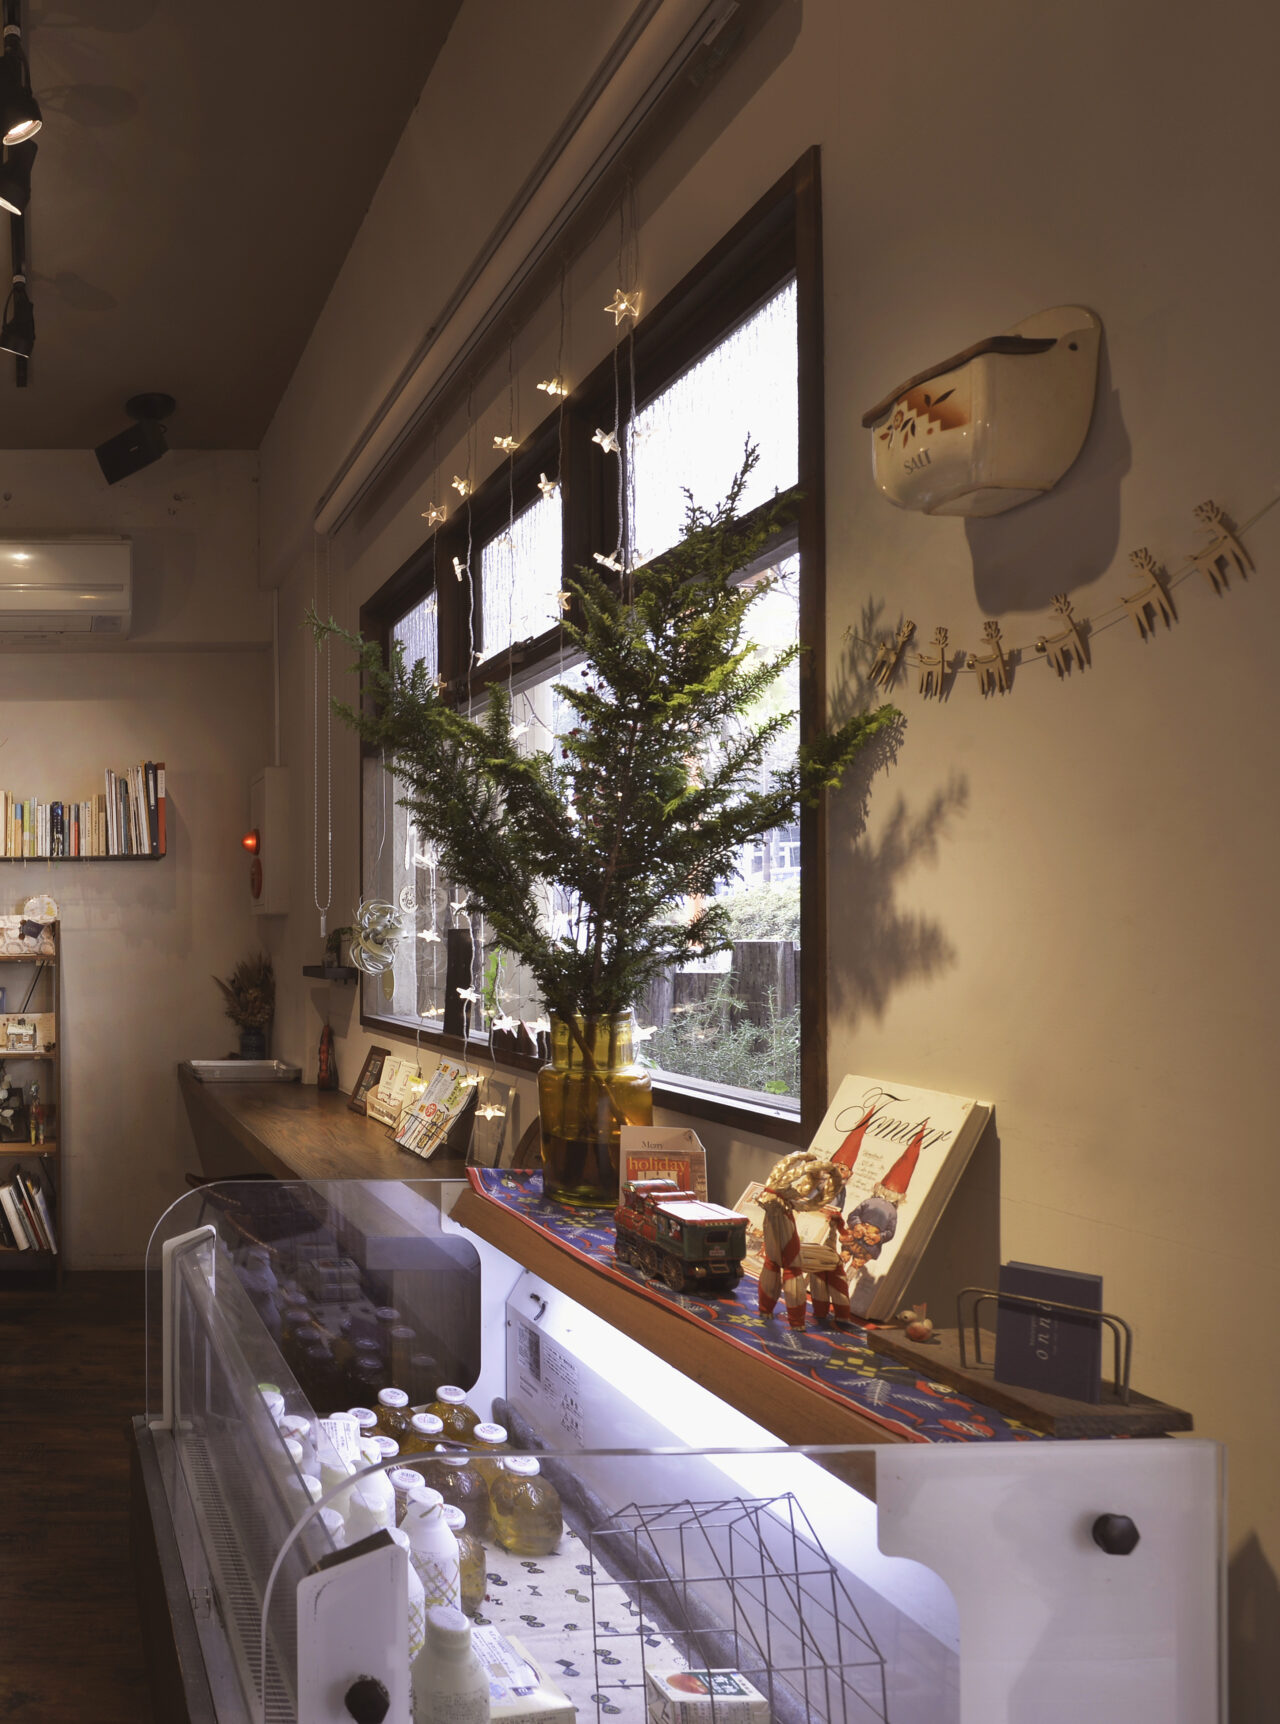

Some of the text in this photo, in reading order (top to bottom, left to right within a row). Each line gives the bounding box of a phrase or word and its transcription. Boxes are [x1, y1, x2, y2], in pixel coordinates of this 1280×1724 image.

[903, 447, 932, 475] SALT
[834, 1087, 953, 1149] Tomtar
[641, 1141, 665, 1150] Merry
[629, 1156, 687, 1176] holiday
